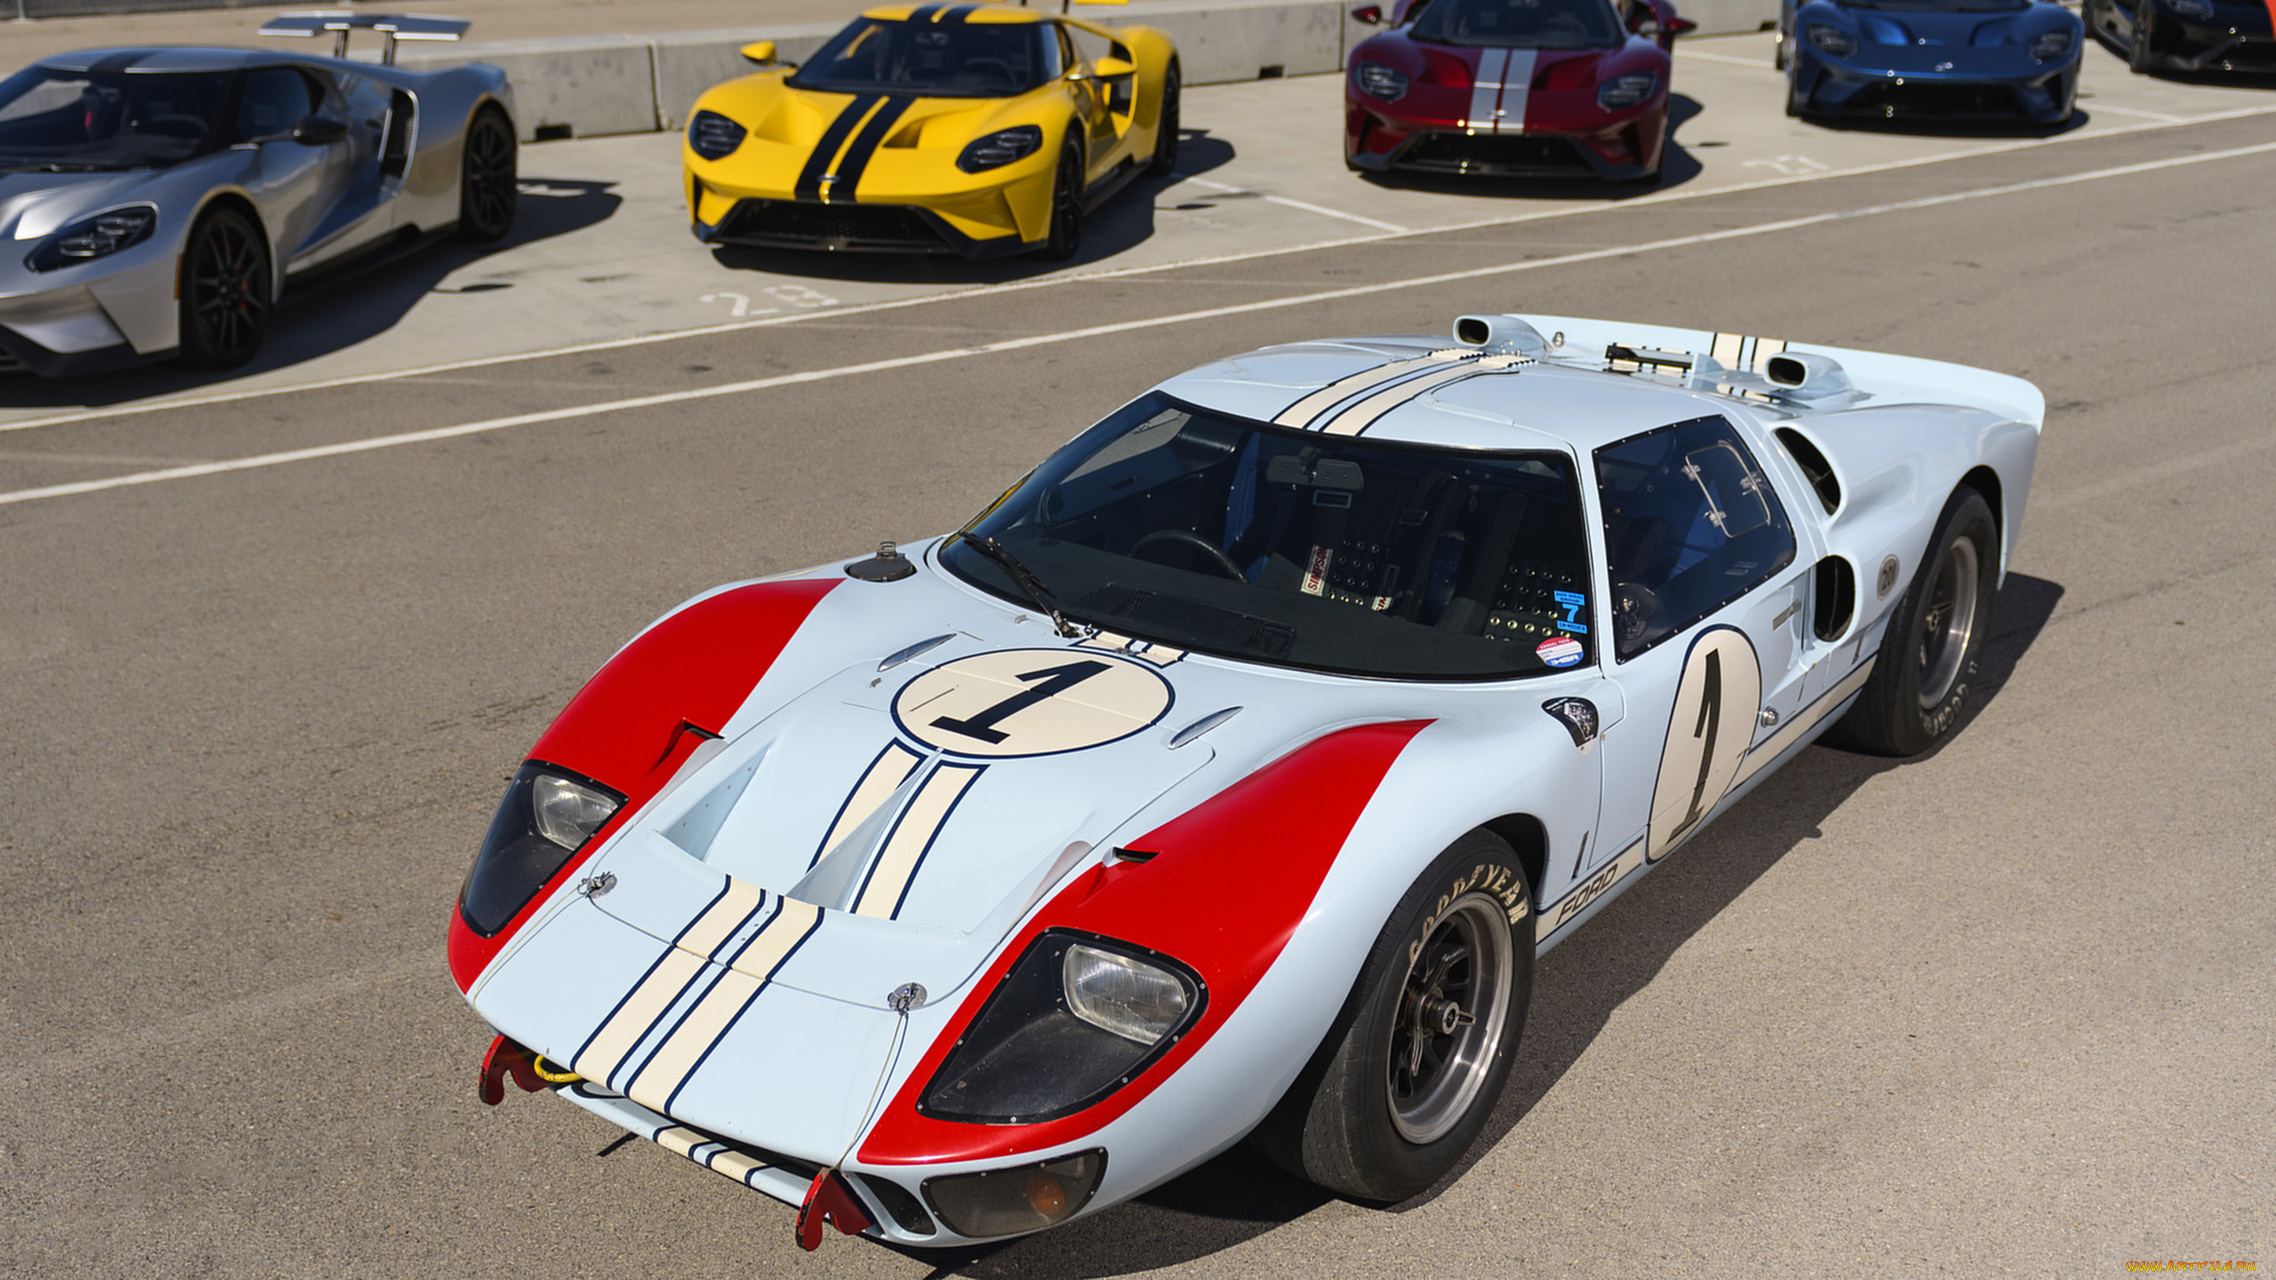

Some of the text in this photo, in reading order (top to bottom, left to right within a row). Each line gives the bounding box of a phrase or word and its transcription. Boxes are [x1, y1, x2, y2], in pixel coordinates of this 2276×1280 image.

[1307, 546, 1329, 591] SIMPSON
[1562, 603, 1579, 623] 7
[928, 660, 1114, 745] 1
[1664, 648, 1722, 846] 1
[1555, 863, 1619, 926] FORD
